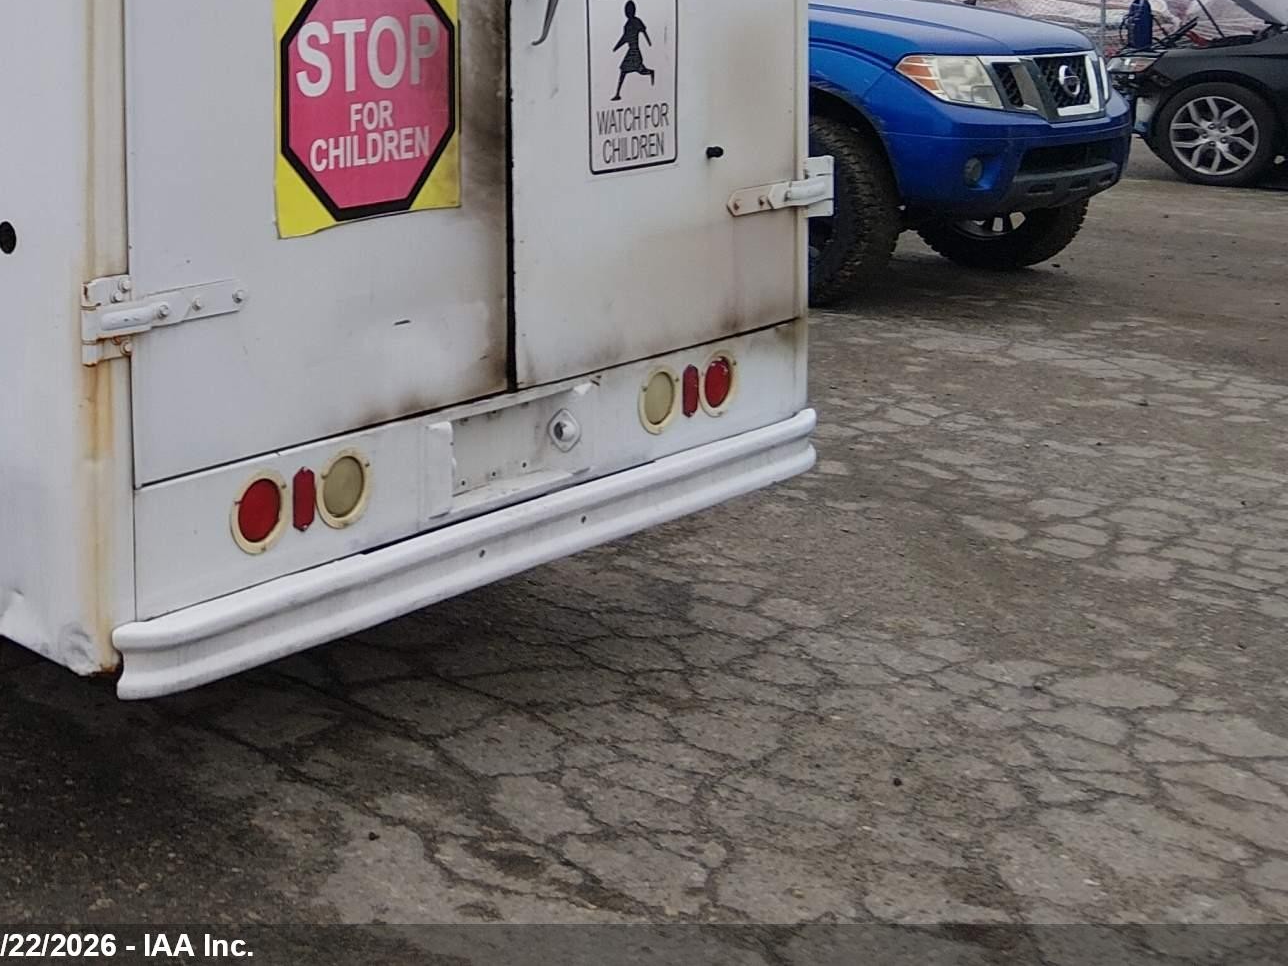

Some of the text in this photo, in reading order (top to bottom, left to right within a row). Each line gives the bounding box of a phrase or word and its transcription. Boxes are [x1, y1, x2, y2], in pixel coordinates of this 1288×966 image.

[296, 14, 439, 98] STOP
[350, 100, 394, 133] FOR
[596, 102, 669, 135] WATCH FOR
[310, 126, 430, 172] CHILDREN
[602, 131, 664, 164] CHILDREN
